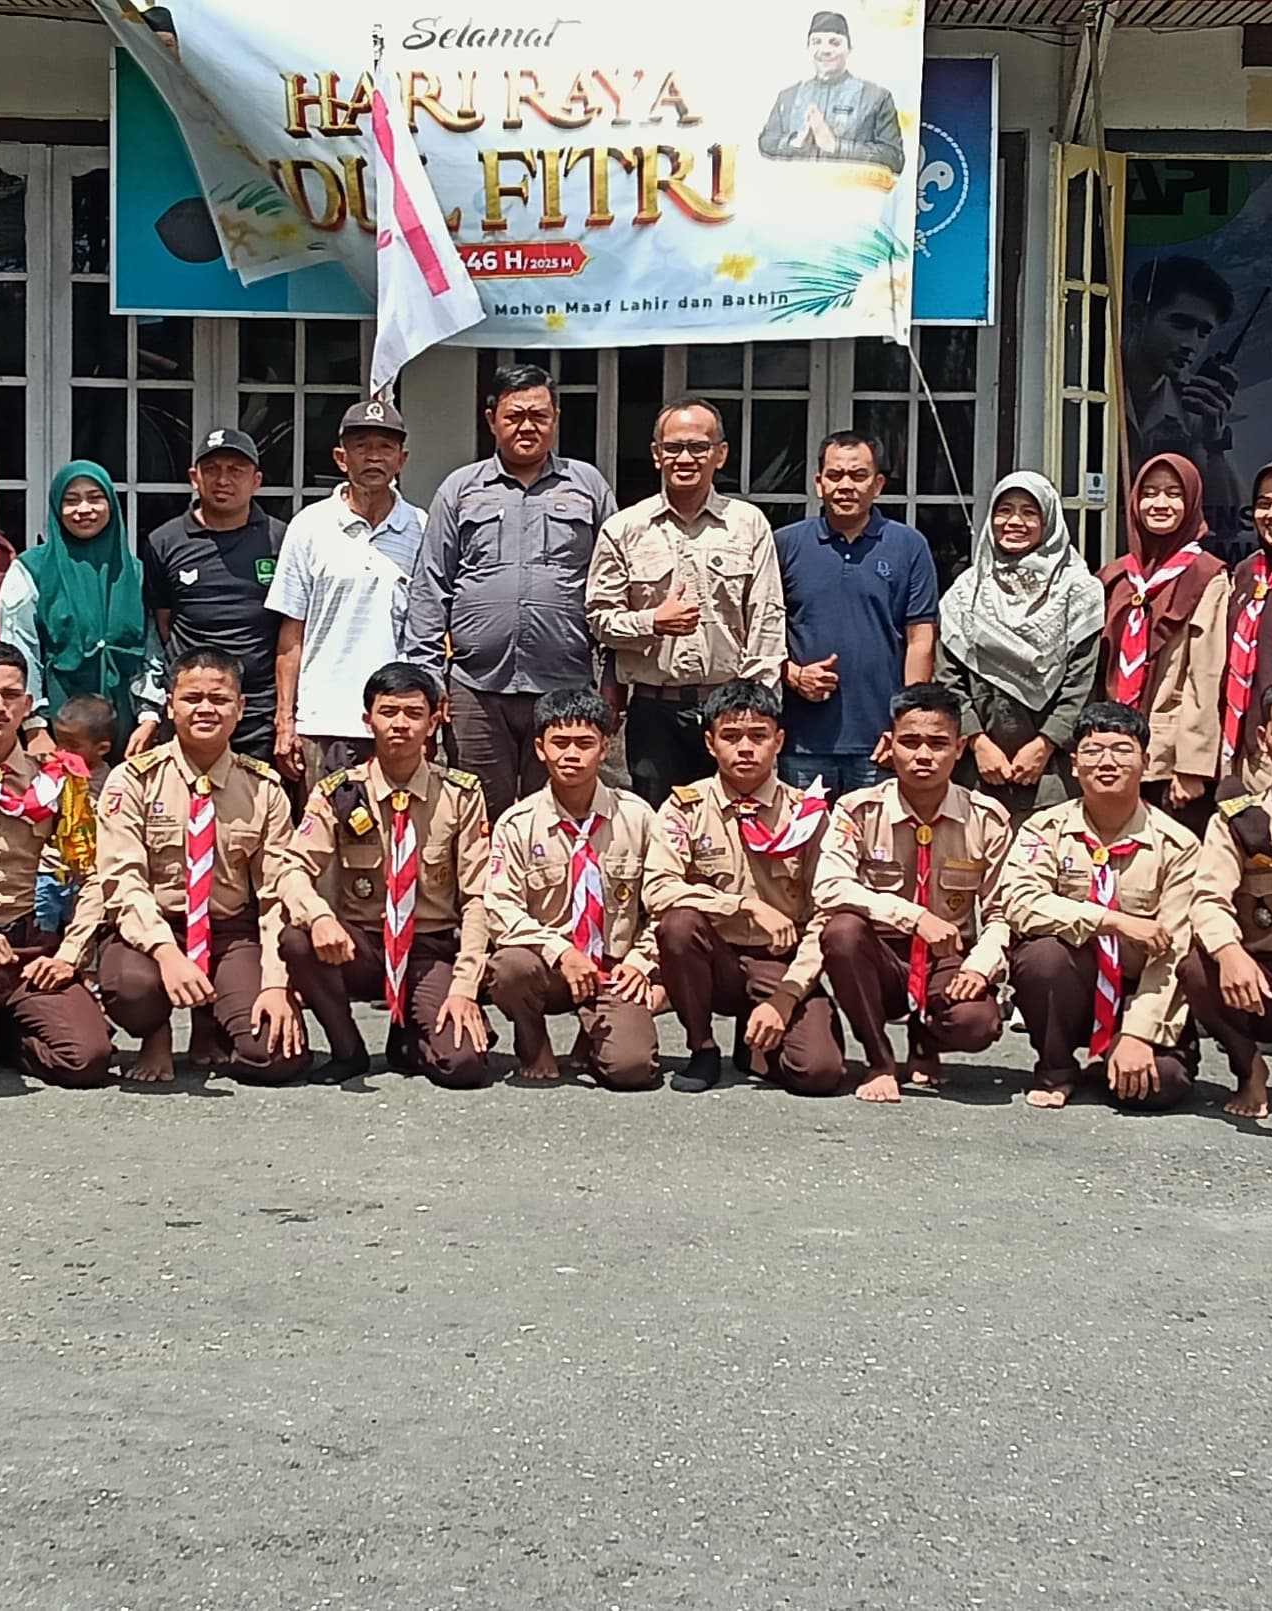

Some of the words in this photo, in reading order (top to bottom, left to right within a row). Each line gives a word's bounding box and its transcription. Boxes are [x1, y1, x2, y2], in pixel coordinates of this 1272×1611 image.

[402, 16, 581, 50] Selamat
[279, 69, 485, 138] HARI
[502, 69, 704, 130] RAYA
[478, 143, 741, 231] FITRI
[561, 257, 572, 267] M
[494, 302, 557, 315] Mohon
[565, 299, 612, 314] Maaf
[620, 295, 670, 312] Lahir
[678, 295, 713, 308] dan
[722, 291, 789, 307] Bathin
